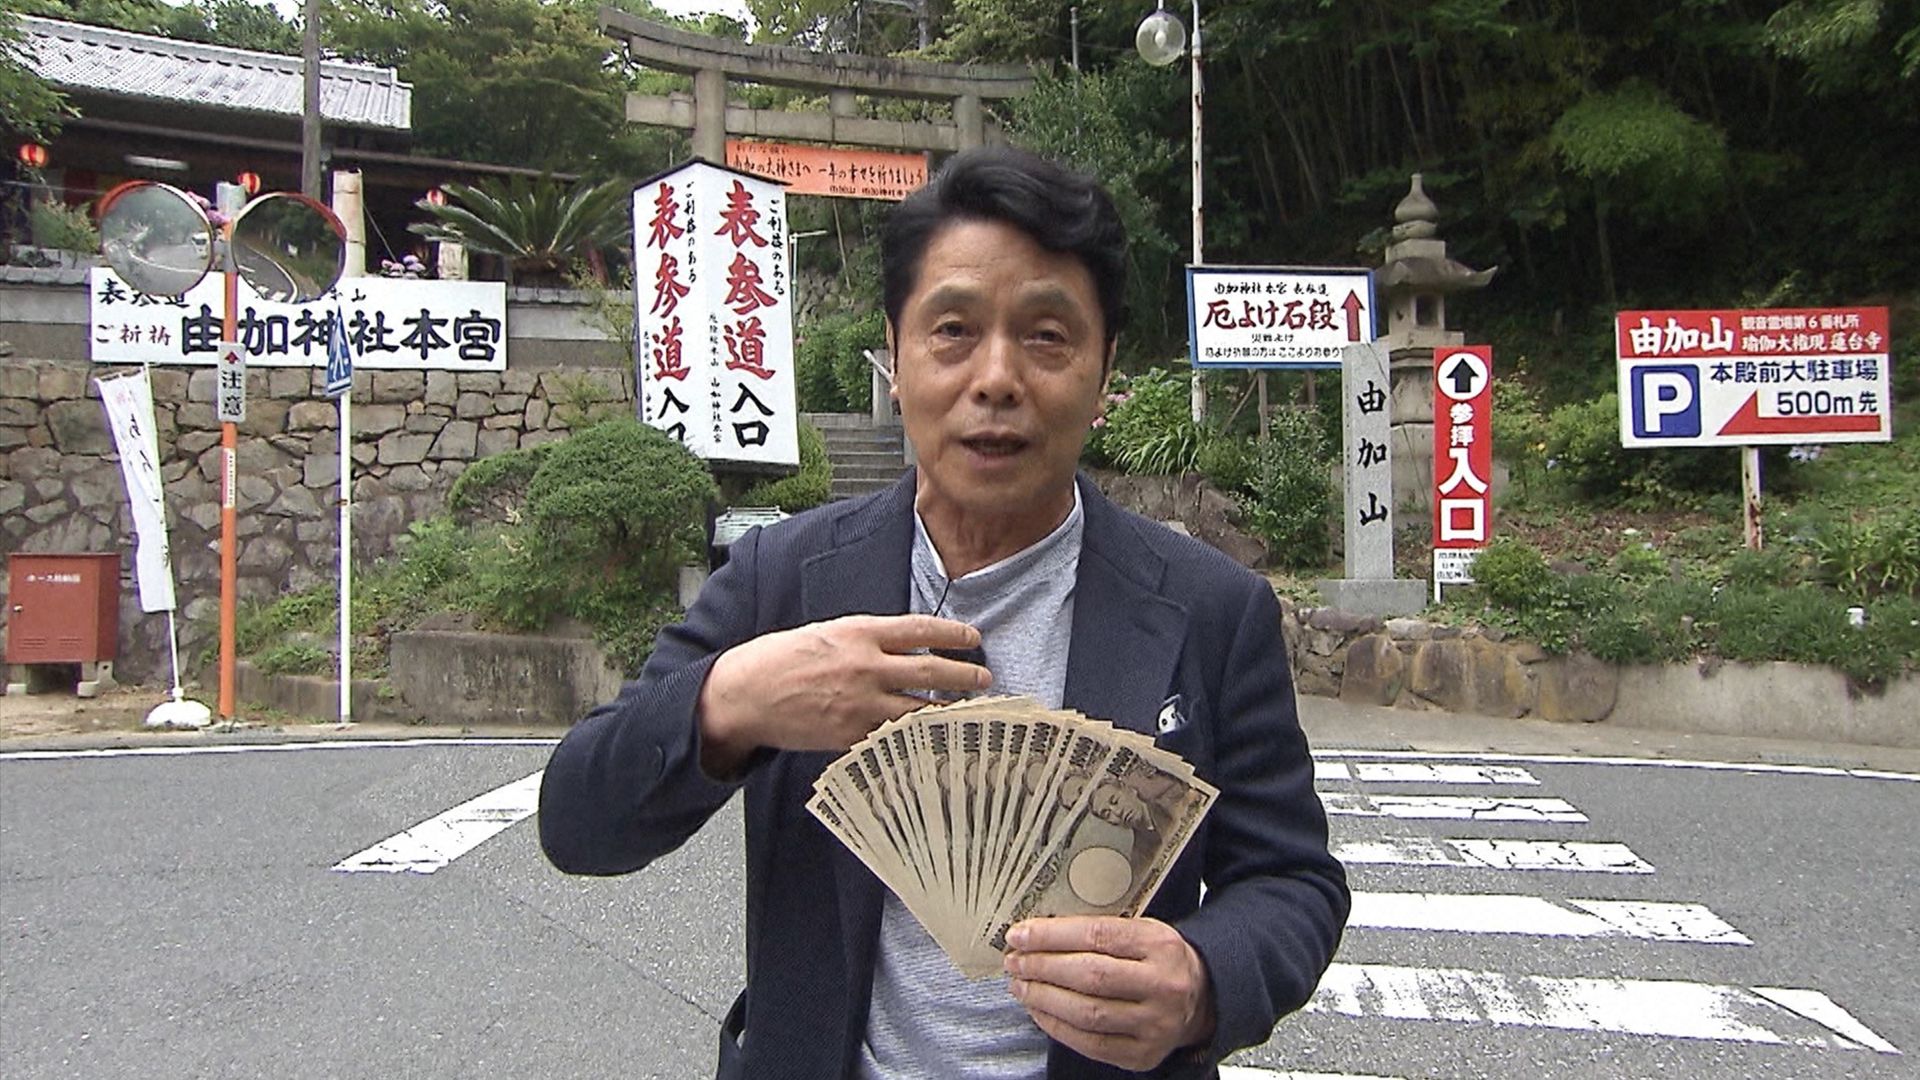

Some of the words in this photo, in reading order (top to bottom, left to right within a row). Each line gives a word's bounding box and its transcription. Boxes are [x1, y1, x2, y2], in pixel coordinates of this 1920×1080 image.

[767, 199, 785, 296] ご利益のある
[181, 304, 501, 361] 由加神社本宮
[714, 179, 778, 448] 表参道入口
[1202, 299, 1339, 331] 厄よけ石段
[1629, 317, 1735, 356] 由加山
[221, 370, 242, 416] 注意
[1710, 360, 1878, 384] 本殿前大駐車場
[1643, 372, 1693, 432] P
[1357, 380, 1388, 527] 由加山
[1438, 402, 1488, 542] 参拝入口
